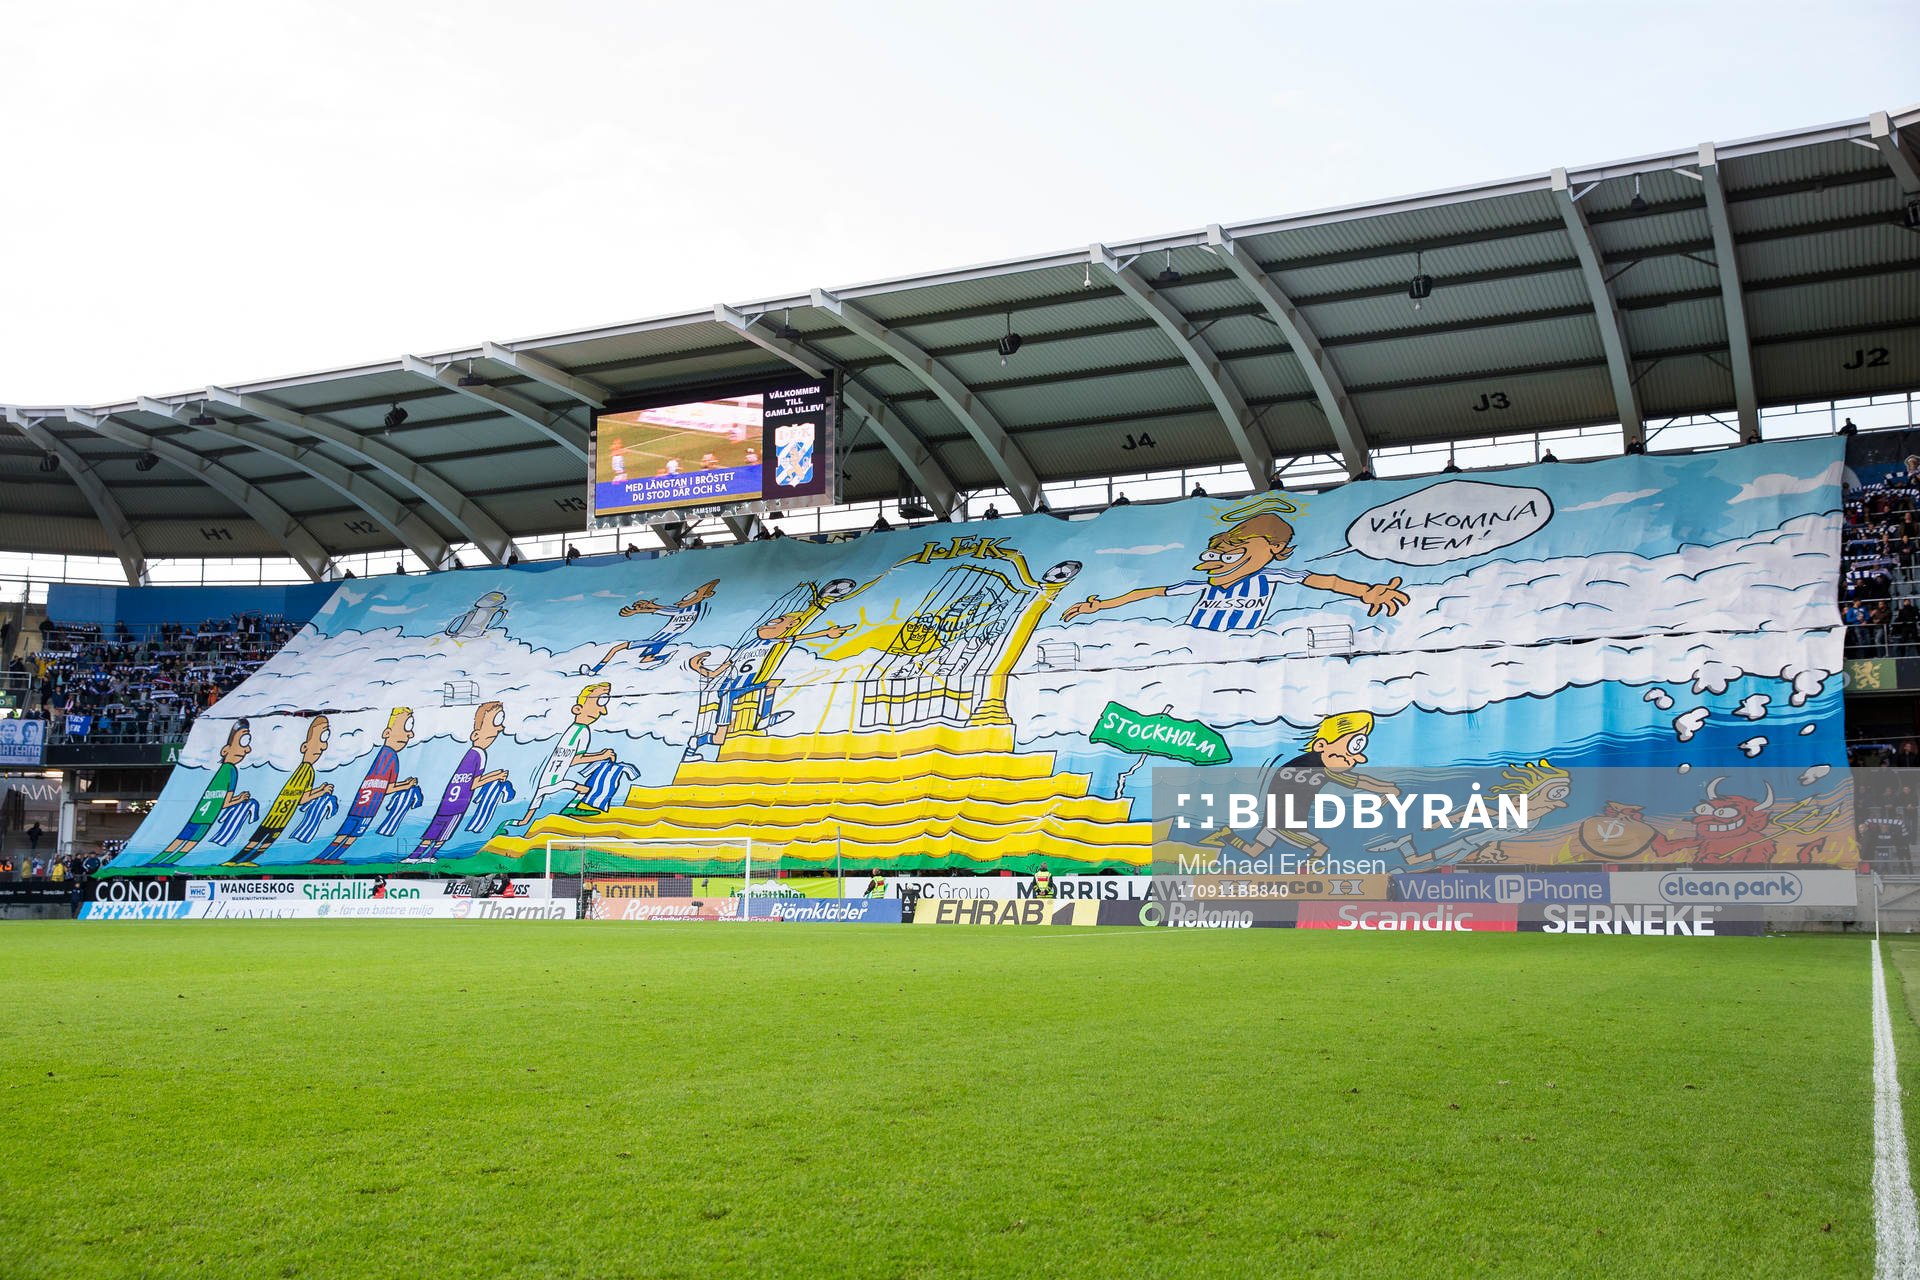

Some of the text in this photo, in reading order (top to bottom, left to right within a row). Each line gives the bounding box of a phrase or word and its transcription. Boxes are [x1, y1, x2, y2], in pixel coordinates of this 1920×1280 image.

[1843, 347, 1890, 370] J2
[769, 386, 820, 399] VÄLKOMMEN
[785, 398, 803, 406] TILL
[1472, 392, 1511, 411] J3
[765, 403, 824, 417] GAMLA ULLEVI
[1121, 432, 1156, 450] J4
[625, 484, 643, 493] MED
[646, 477, 687, 491] LÄNGTAN
[695, 472, 736, 485] BRÖSTET
[633, 481, 728, 502] DU STOD DÄR OCH SA
[553, 497, 588, 512] H3
[692, 506, 722, 515] SAMSUNG
[1370, 500, 1537, 533] VÄLKOMNA
[201, 528, 233, 541] H1
[343, 520, 381, 534] H2
[1199, 598, 1268, 610] NILSSON
[673, 623, 687, 632] 7
[740, 658, 755, 673] 6
[1103, 712, 1216, 757] STOCKHOLM
[549, 760, 563, 772] 17
[451, 773, 473, 783] BERG
[1280, 767, 1325, 786] 666
[358, 789, 372, 804] 3
[448, 785, 461, 802] 9
[199, 800, 212, 816] 4
[274, 799, 290, 814] 18
[190, 888, 205, 896] WHC
[220, 882, 295, 894] WANGESKOG
[939, 883, 990, 899] Group
[1128, 881, 1187, 900] LAW
[1400, 878, 1491, 899] Weblink
[1528, 878, 1602, 899] Phone
[1665, 877, 1797, 899] clean park
[86, 901, 180, 919] EFFEKTIV
[479, 900, 566, 919] Thermia
[936, 900, 1046, 925] EHRAB
[1168, 902, 1253, 928] Rekomo
[1338, 904, 1473, 931] Scandic
[1541, 904, 1715, 936] SERNEKE
